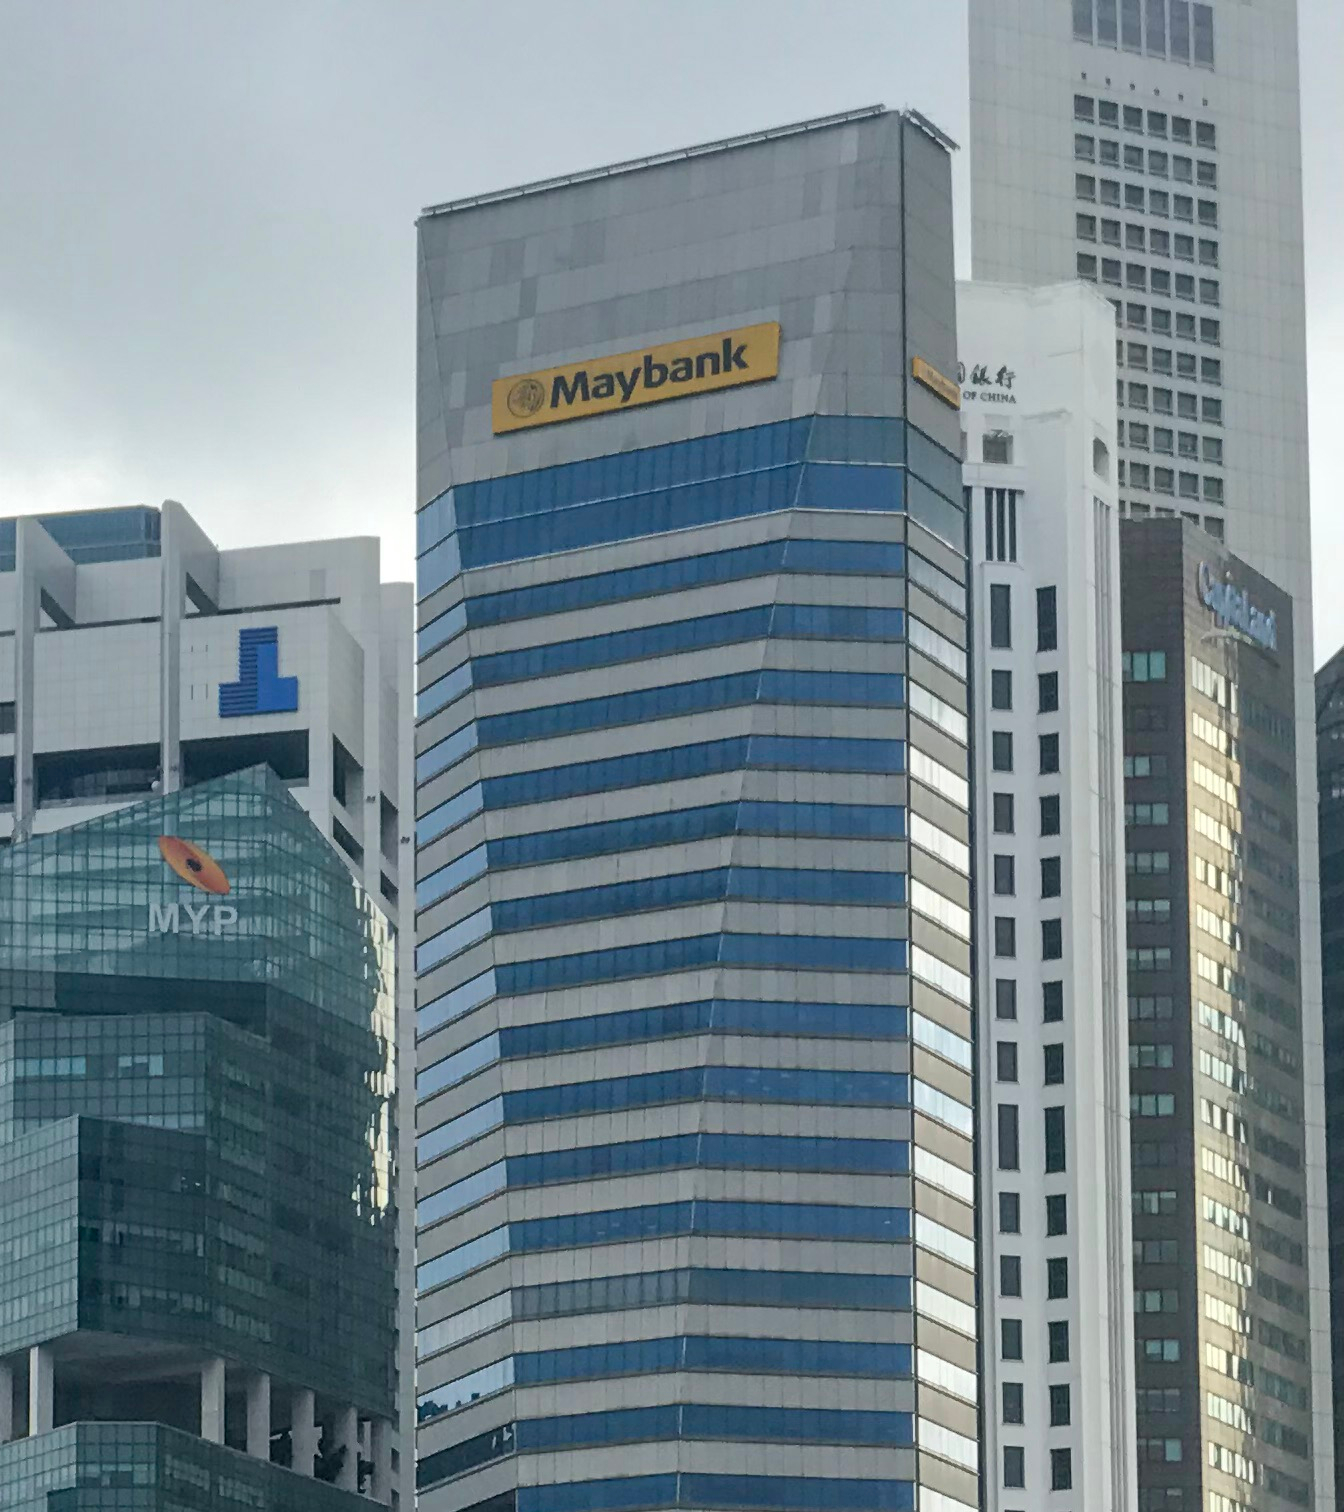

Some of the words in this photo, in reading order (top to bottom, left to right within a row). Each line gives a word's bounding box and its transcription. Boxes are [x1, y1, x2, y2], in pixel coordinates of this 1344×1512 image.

[550, 337, 749, 408] Maybank
[980, 391, 1017, 404] CHINA
[148, 902, 238, 936] MYP
